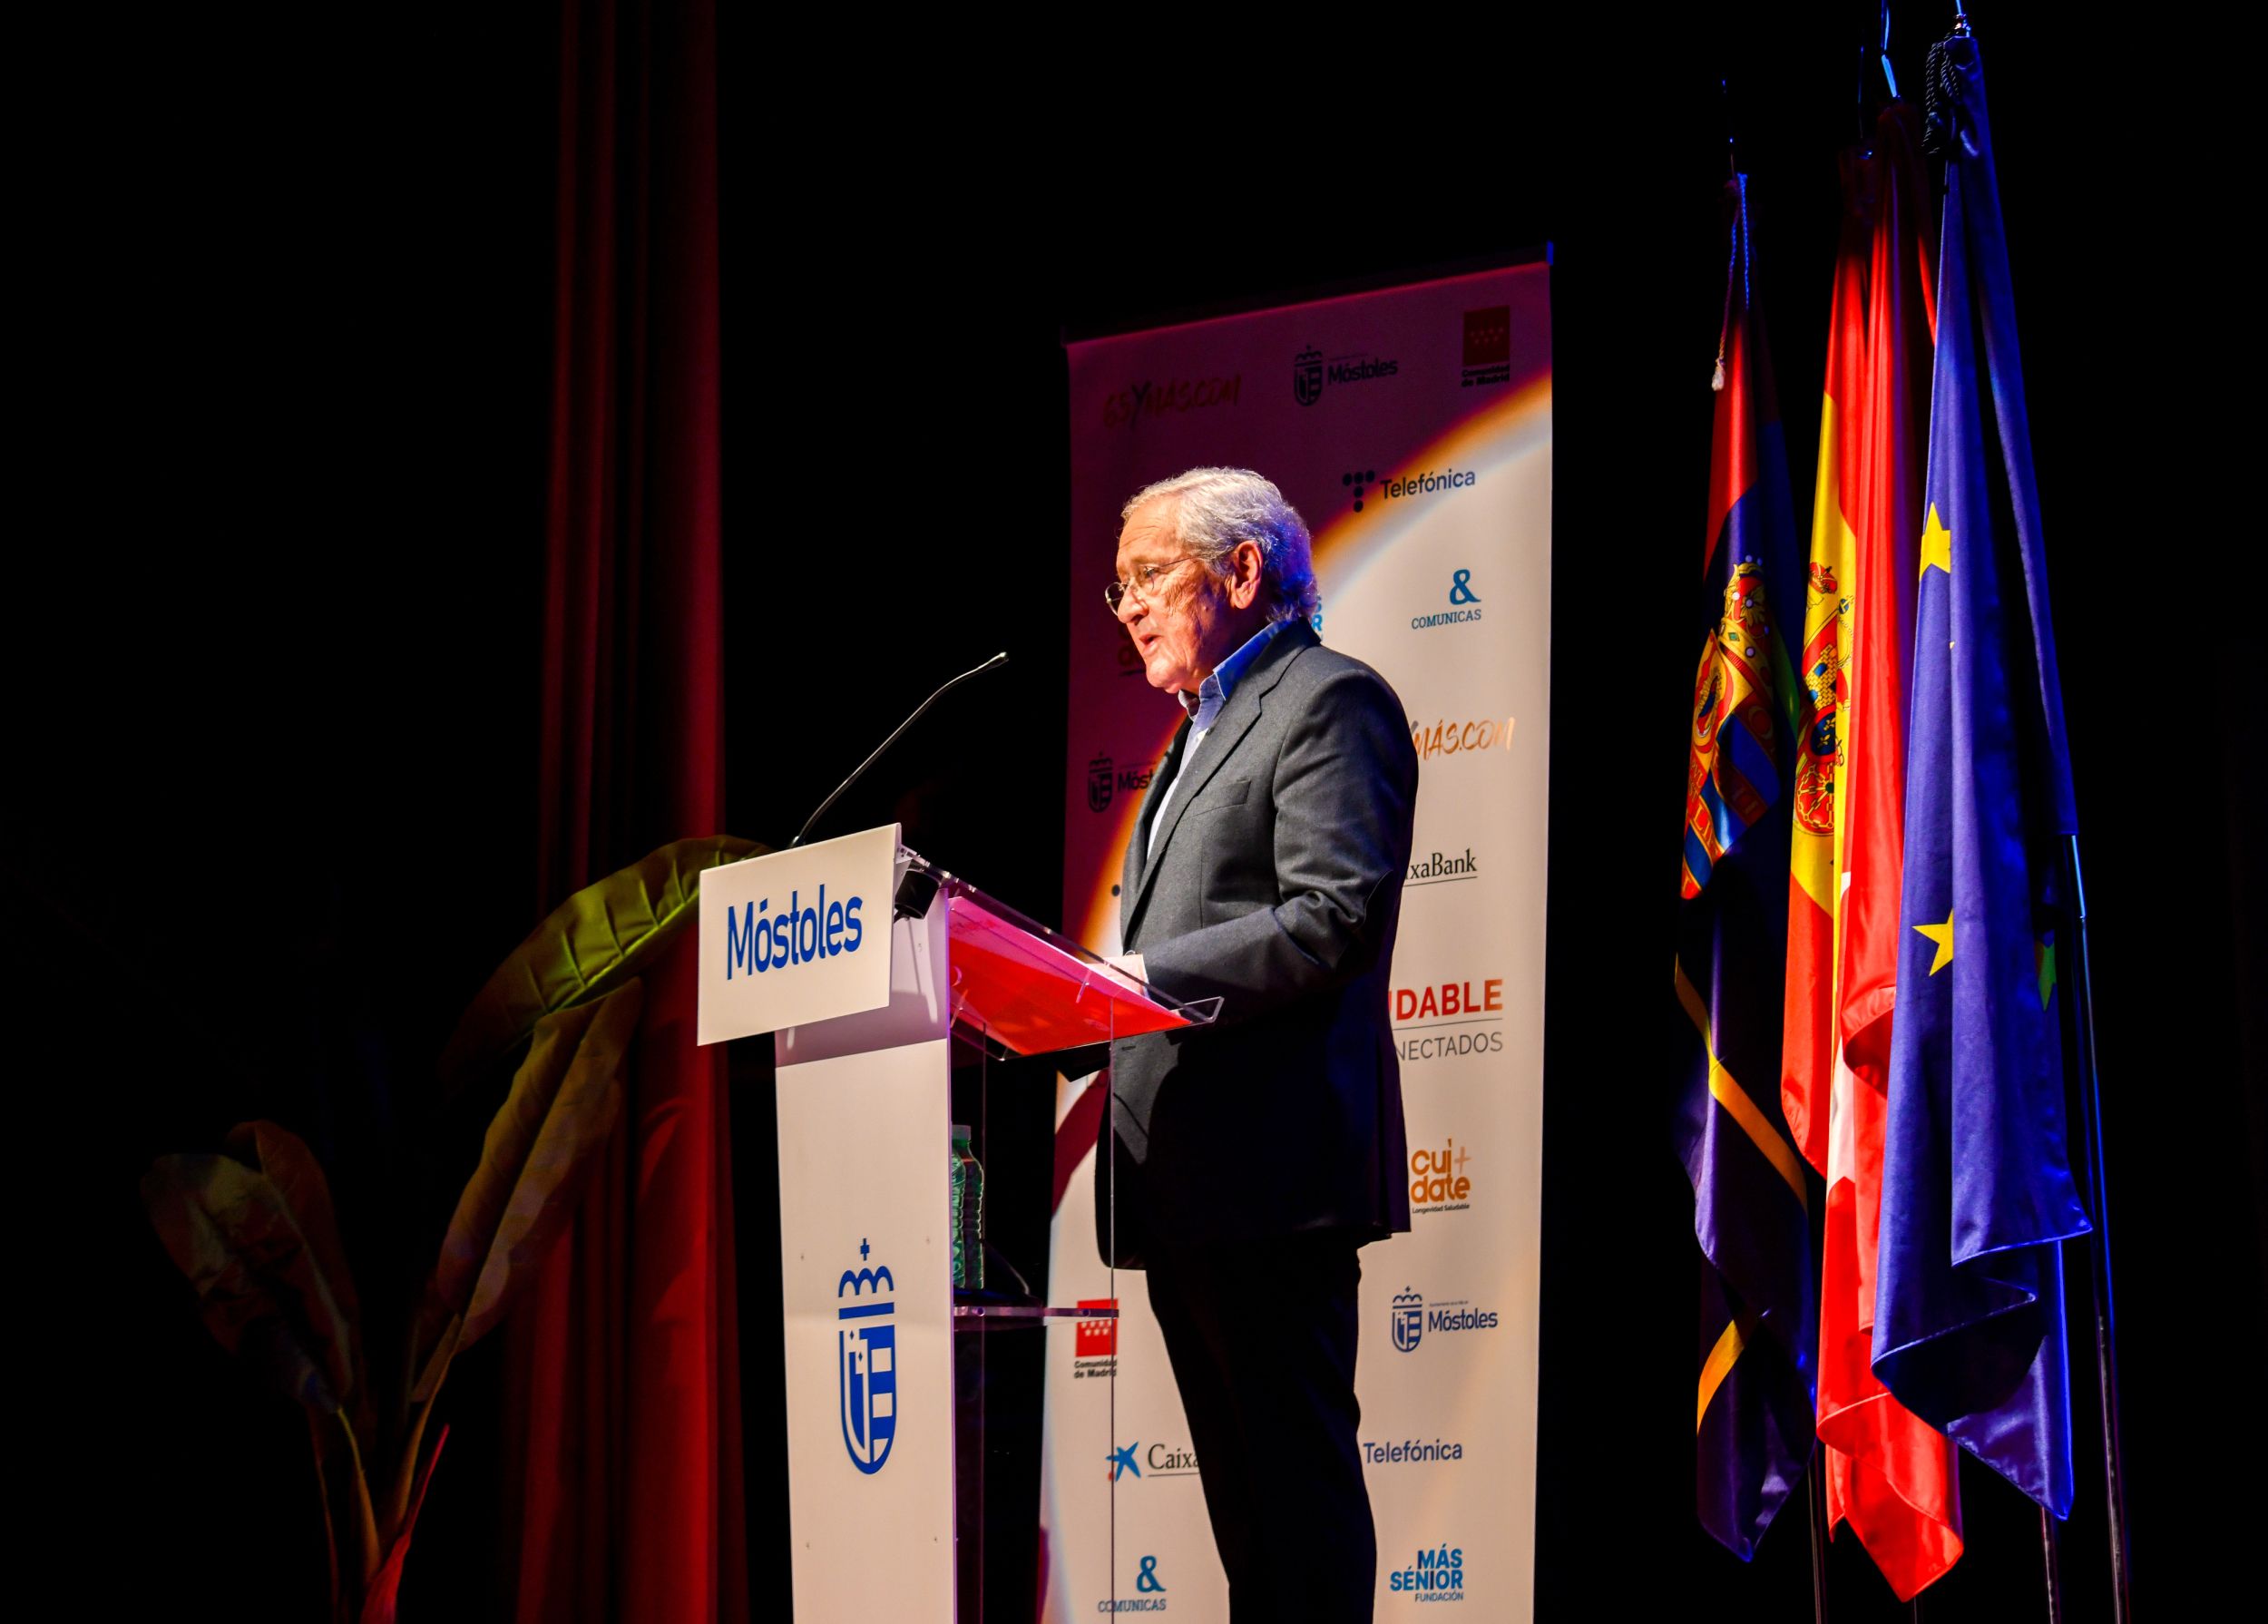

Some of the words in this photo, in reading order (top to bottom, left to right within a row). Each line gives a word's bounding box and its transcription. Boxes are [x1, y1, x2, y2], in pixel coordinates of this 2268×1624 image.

[1328, 358, 1398, 386] Móstoles
[1380, 468, 1476, 499] Telefónica
[1450, 569, 1481, 605] &
[1412, 609, 1481, 630] COMUNICAS
[1411, 717, 1515, 760] MÁS.COM
[1405, 848, 1477, 880] xaBank
[727, 884, 863, 980] Móstoles
[1388, 979, 1502, 1021] DABLE
[1396, 1032, 1502, 1061] NECTADOS
[1411, 1174, 1471, 1204] date
[1428, 1307, 1499, 1332] Móstoles
[1074, 1370, 1084, 1378] de
[1364, 1439, 1462, 1463] Telefónica
[1417, 1543, 1463, 1570] MÁS
[1136, 1555, 1167, 1592] &
[1390, 1565, 1463, 1590] SÉNIOR
[1098, 1599, 1167, 1612] COMUNICAS
[1415, 1590, 1463, 1602] FUNDACIÓN
